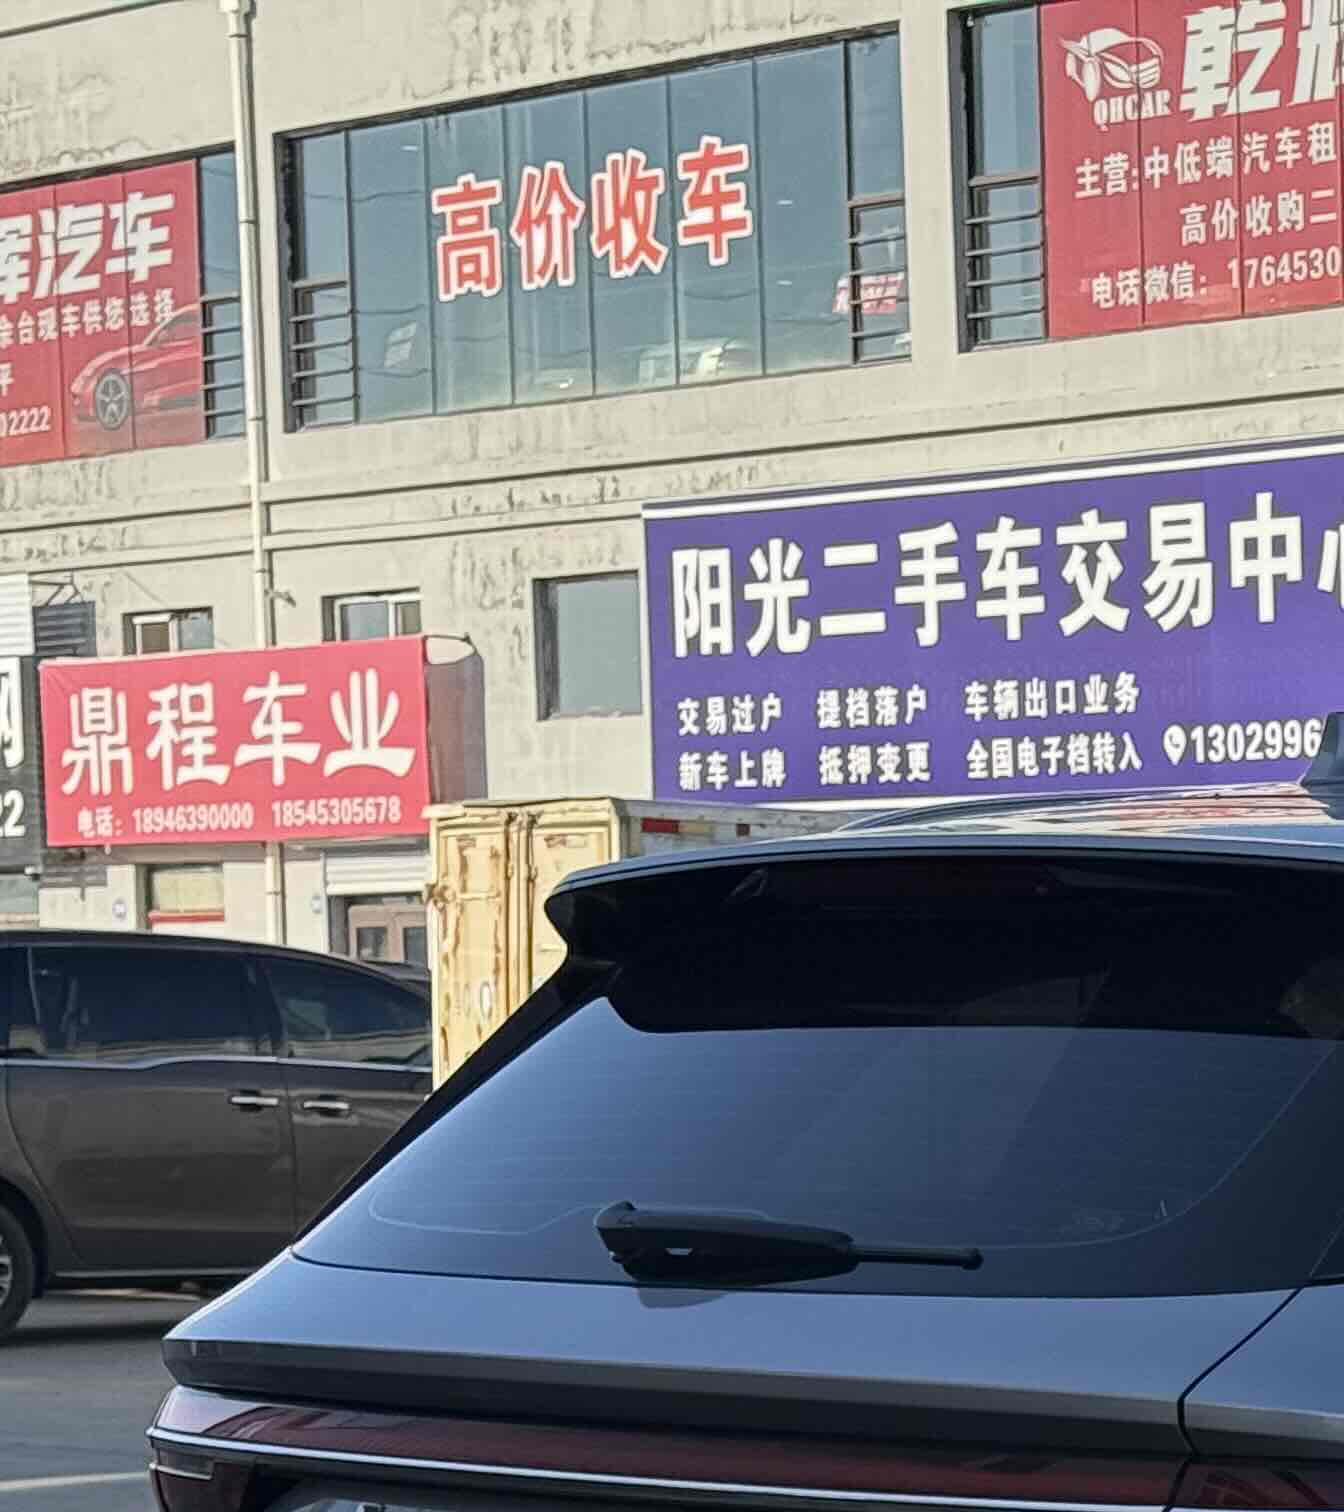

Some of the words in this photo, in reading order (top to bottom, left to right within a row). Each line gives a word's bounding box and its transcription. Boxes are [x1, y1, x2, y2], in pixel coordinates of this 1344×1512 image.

[1093, 89, 1172, 131] QHCAR
[430, 134, 755, 303] 高价收车
[60, 667, 417, 796] 鼎程车业
[677, 692, 783, 736] 交易过户
[816, 684, 928, 728] 提档落户
[964, 671, 1140, 722] 车辆出口业务
[678, 747, 787, 791] 新车上牌
[818, 741, 931, 786] 抵押变更
[966, 731, 1143, 780] 全国电子档转入
[132, 802, 254, 833] 18946390000
[272, 796, 401, 829] 18545305678
